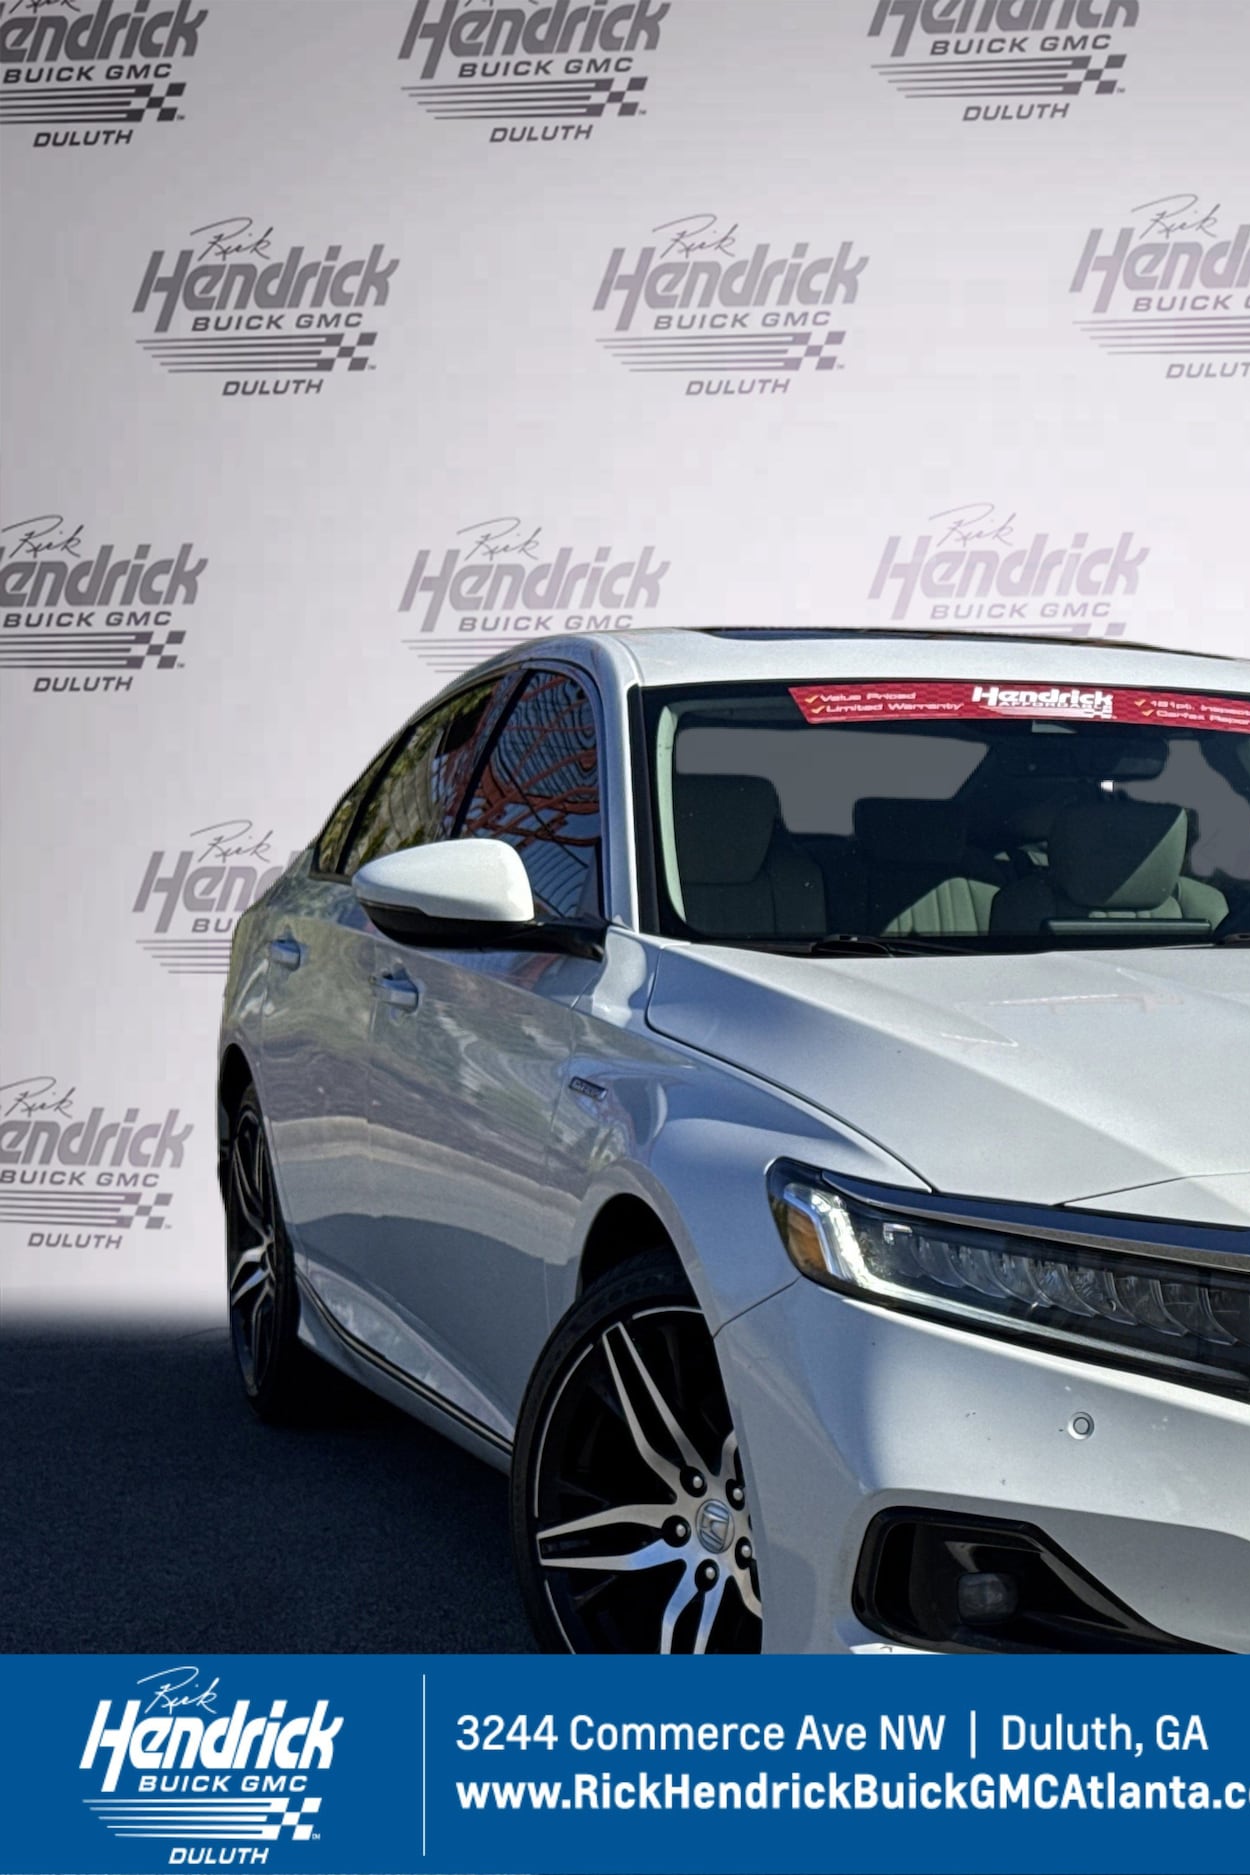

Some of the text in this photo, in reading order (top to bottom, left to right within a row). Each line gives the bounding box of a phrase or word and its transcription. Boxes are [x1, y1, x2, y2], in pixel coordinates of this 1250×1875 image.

[0, 0, 208, 62] endrick
[398, 0, 671, 79] Hendrick
[930, 34, 1111, 55] BUICK GMC
[3, 63, 172, 84] BUICK GMC
[458, 57, 633, 78] BUICK GMC
[962, 103, 1070, 121] DULUTH
[33, 129, 133, 147] DULUTH
[489, 124, 593, 143] DULUTH
[132, 244, 399, 332] Hendrick
[593, 241, 870, 331] Hendrick
[1133, 294, 1233, 312] BUICK
[192, 312, 363, 332] BUICK GMC
[654, 311, 831, 330] BUICK GMC
[222, 379, 323, 396] DULUTH
[685, 379, 790, 396] DULUTH
[0, 543, 208, 607] endrick
[868, 532, 1150, 620] Hendrick
[398, 546, 671, 632] Hendrick
[3, 611, 171, 628] BUICK GMC
[930, 602, 1111, 620] BUICK GMC
[458, 615, 633, 632] BUICK GMC
[33, 676, 133, 692] DULUTH
[820, 692, 916, 702] Value Priced
[972, 686, 1113, 706] Hendrick
[826, 703, 883, 713] Limited
[0, 1107, 194, 1168] endrick
[0, 1169, 159, 1187] BUICK GMC
[27, 1232, 122, 1249] DULUTH
